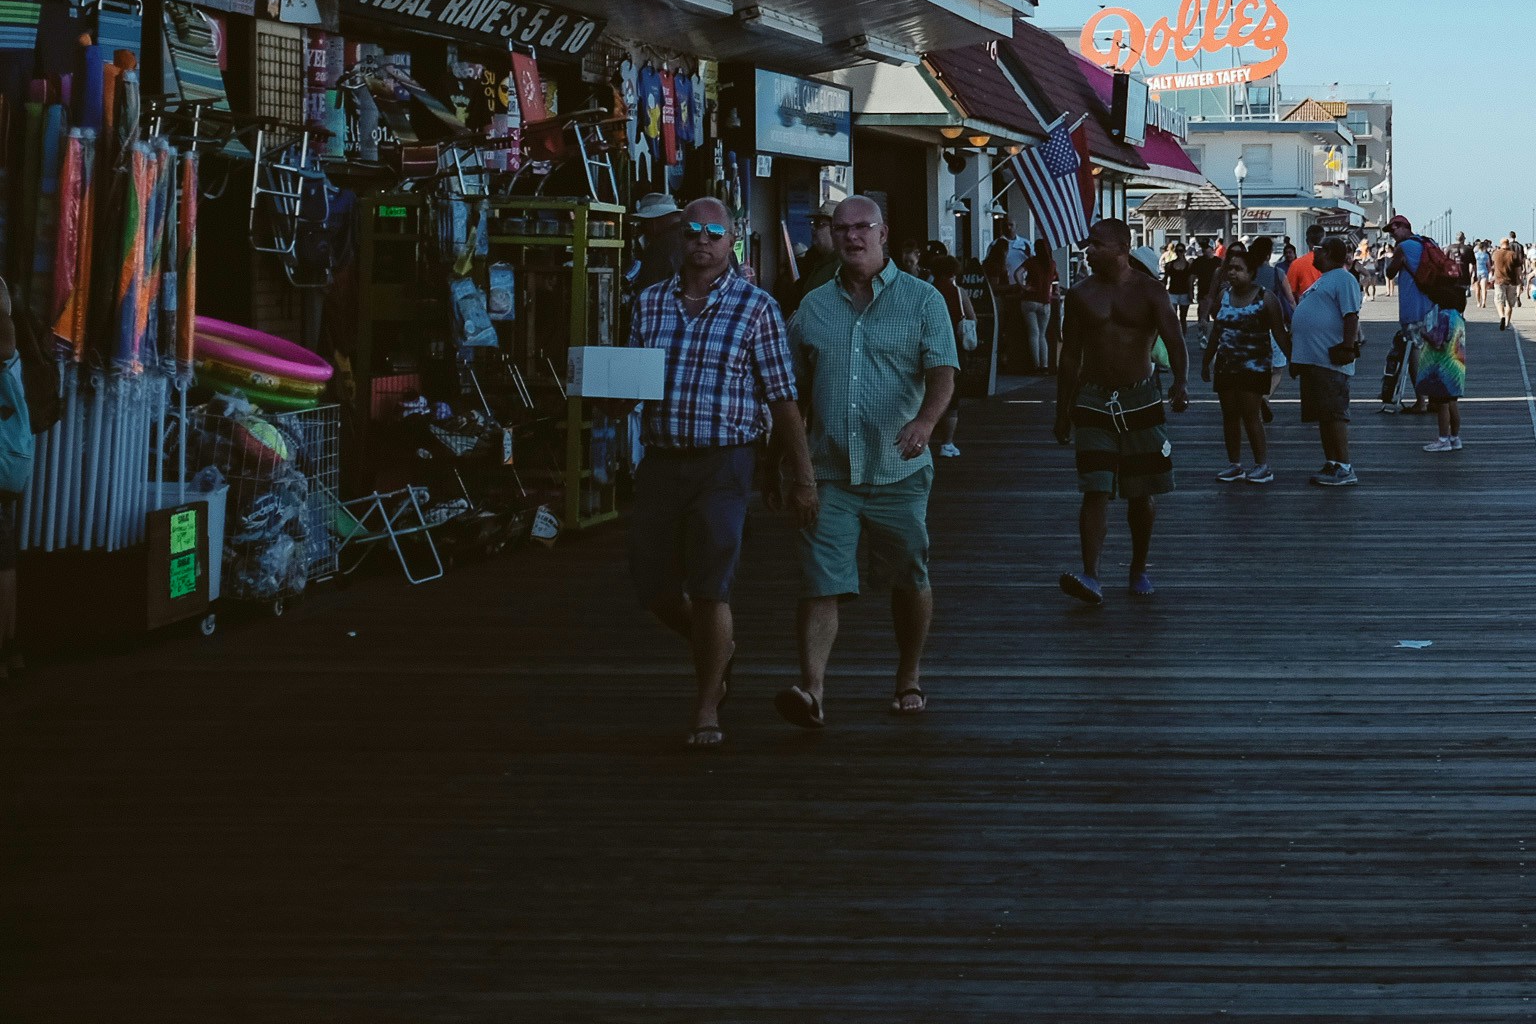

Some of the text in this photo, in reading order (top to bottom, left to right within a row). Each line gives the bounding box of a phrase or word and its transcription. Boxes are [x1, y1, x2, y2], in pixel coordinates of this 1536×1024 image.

[520, 7, 551, 42] 5
[539, 14, 569, 47] &
[560, 20, 596, 54] 10
[1146, 68, 1251, 91] SALT WATER TAFFY
